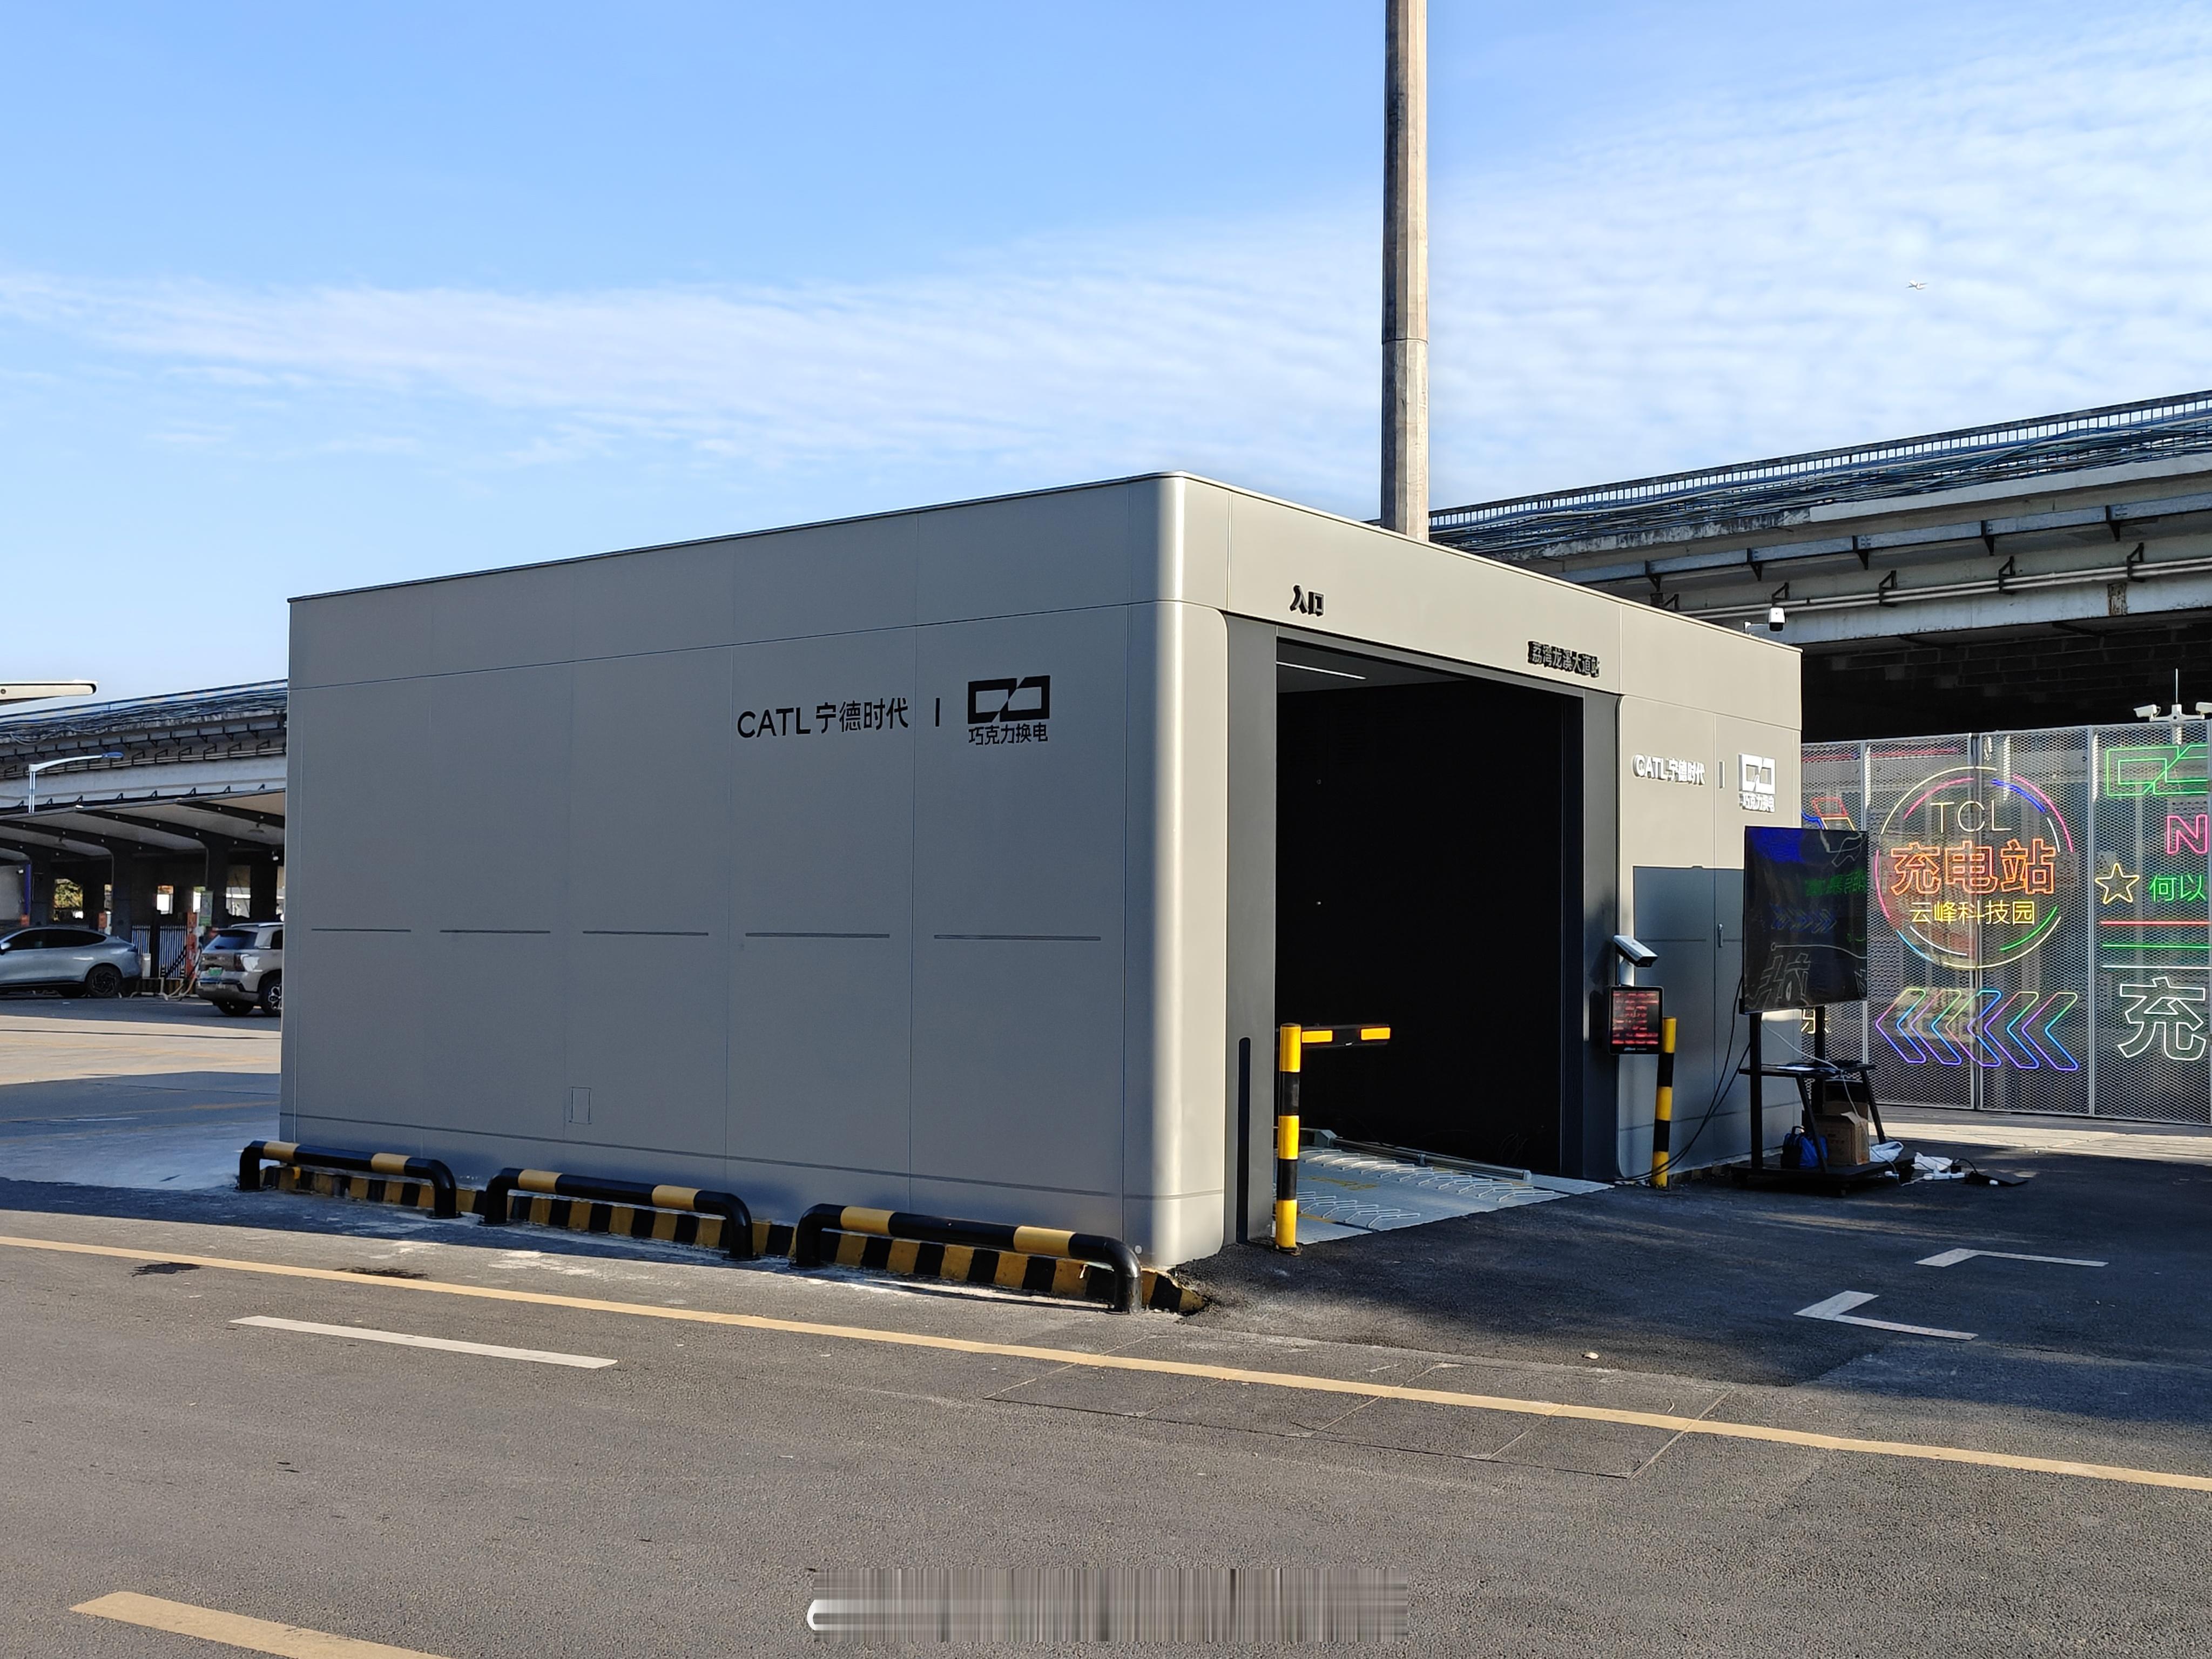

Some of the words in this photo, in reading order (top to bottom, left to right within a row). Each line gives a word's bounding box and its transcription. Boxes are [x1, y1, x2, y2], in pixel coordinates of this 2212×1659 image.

[1290, 584, 1324, 616] 入口
[737, 707, 811, 738] CATL
[815, 698, 909, 734] 宁德时代
[968, 721, 1049, 746] 巧克力换电
[1633, 754, 1666, 780] CATL
[1930, 800, 2012, 834] TCL
[1890, 838, 2056, 896] 充电站
[2148, 873, 2208, 903] 何以
[1908, 899, 2035, 925] 云峰科技园
[2117, 976, 2207, 1061] 充
